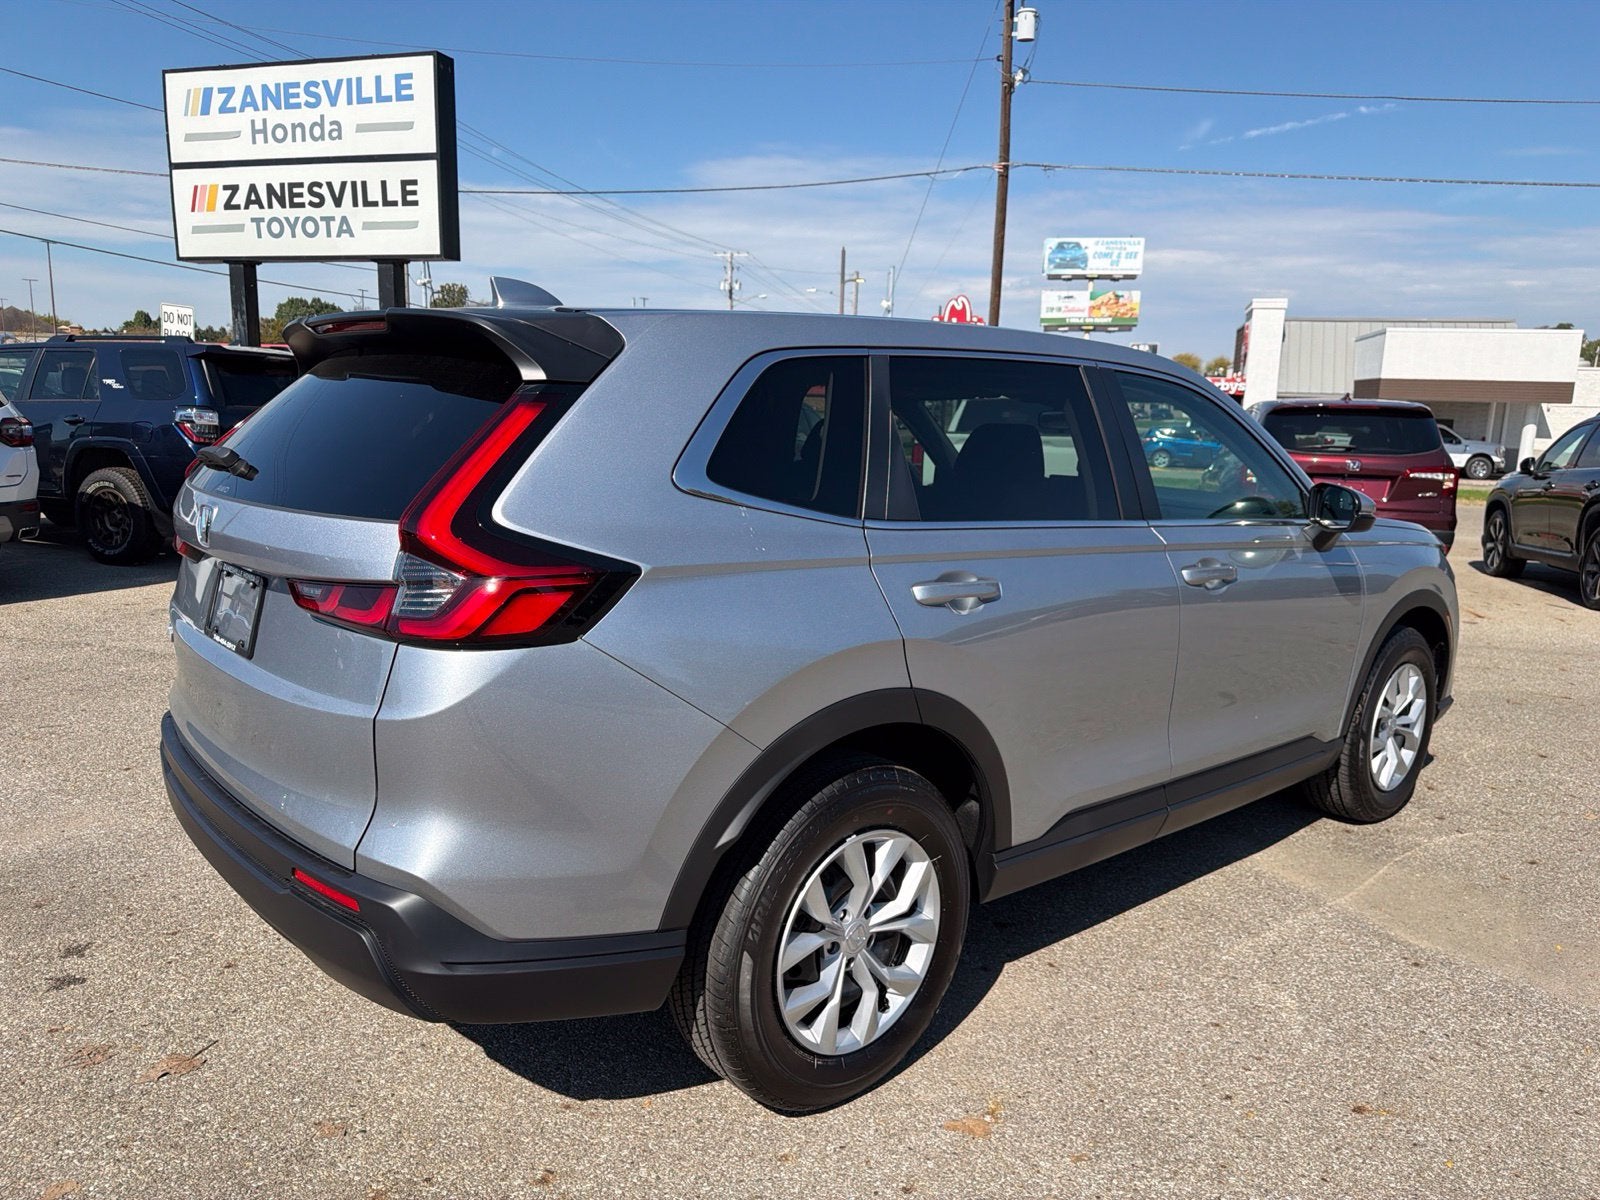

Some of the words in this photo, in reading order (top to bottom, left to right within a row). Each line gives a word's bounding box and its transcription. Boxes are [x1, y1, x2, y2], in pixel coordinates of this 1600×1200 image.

[217, 72, 414, 114] ZANESVILLE
[250, 114, 343, 145] Honda
[223, 179, 419, 211] ZANESVILLE
[250, 215, 355, 239] TOYOTA
[163, 312, 175, 324] DO
[177, 313, 192, 326] NOT
